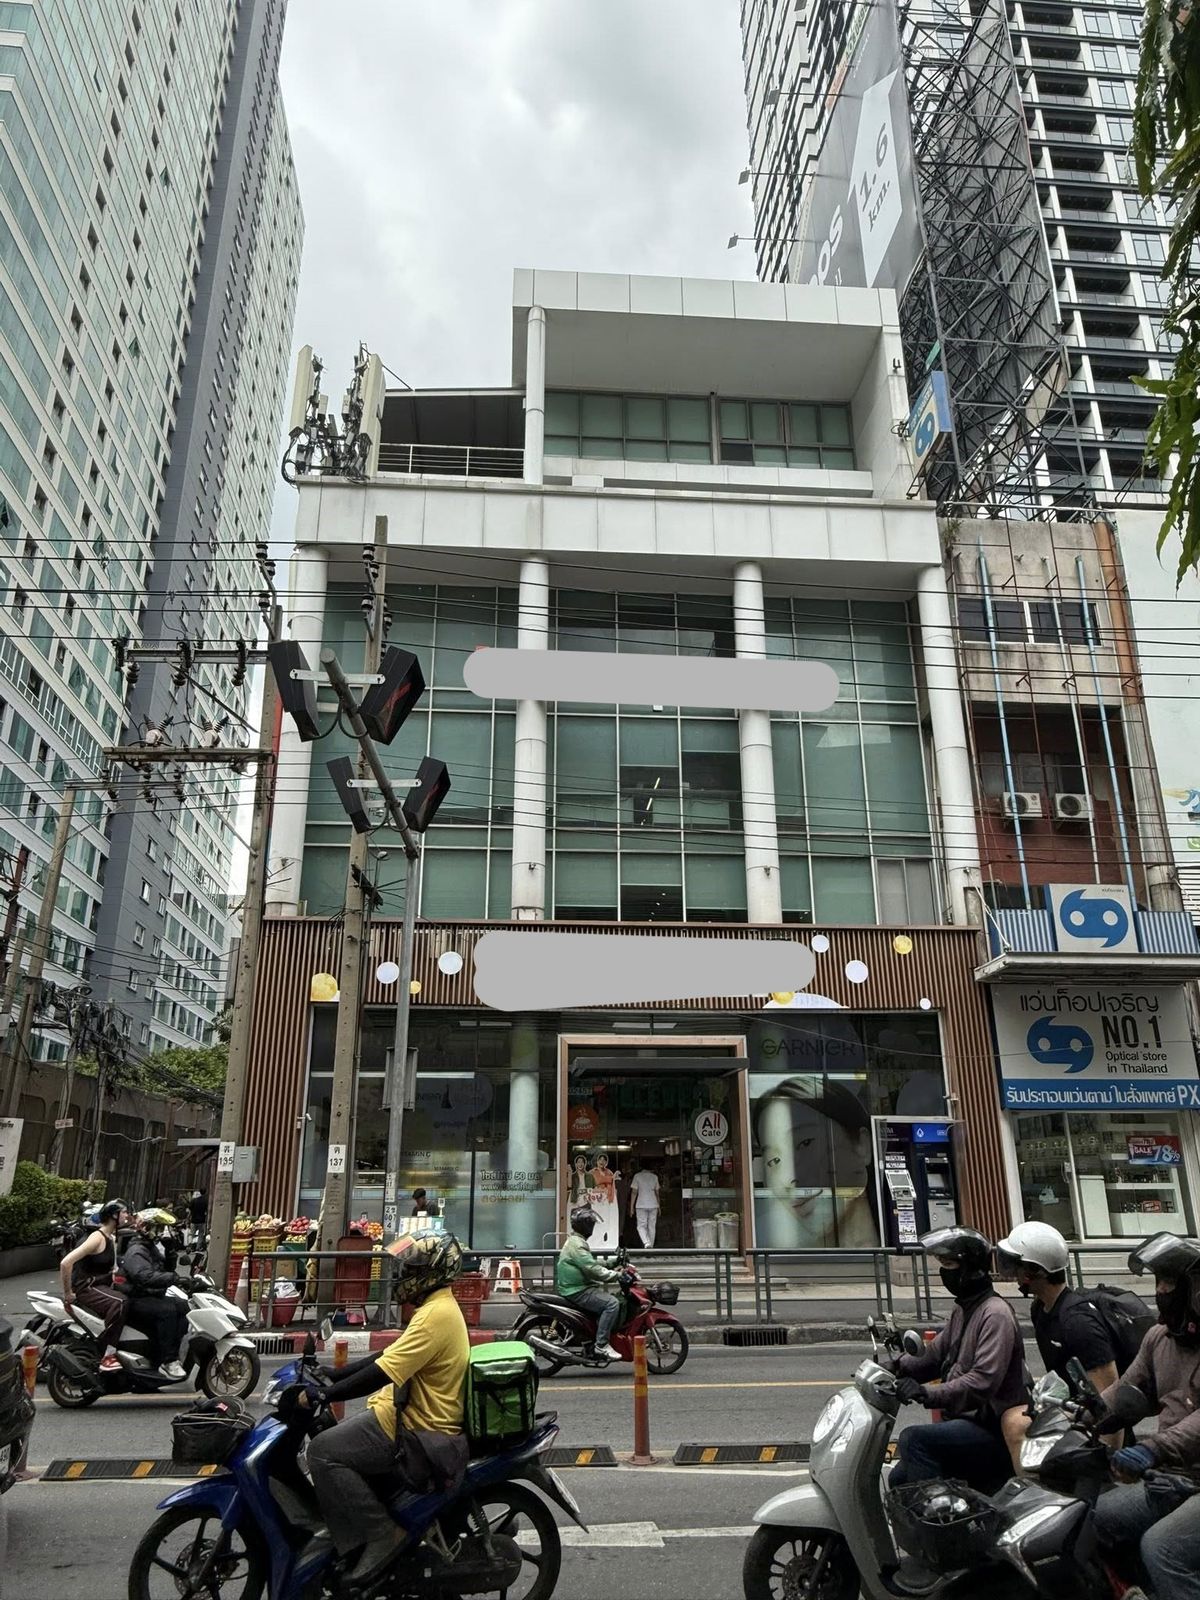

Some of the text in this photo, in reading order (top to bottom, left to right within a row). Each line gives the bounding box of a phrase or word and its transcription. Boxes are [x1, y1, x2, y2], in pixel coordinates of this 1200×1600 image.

[1020, 988, 1159, 1012] แว่นท็อปเจริญ
[761, 1038, 857, 1057] GARNIER
[1105, 1051, 1167, 1062] Optical store
[1107, 1063, 1168, 1074] in Thailand
[702, 1112, 721, 1130] All
[219, 1156, 234, 1165] 135
[329, 1158, 344, 1167] 137
